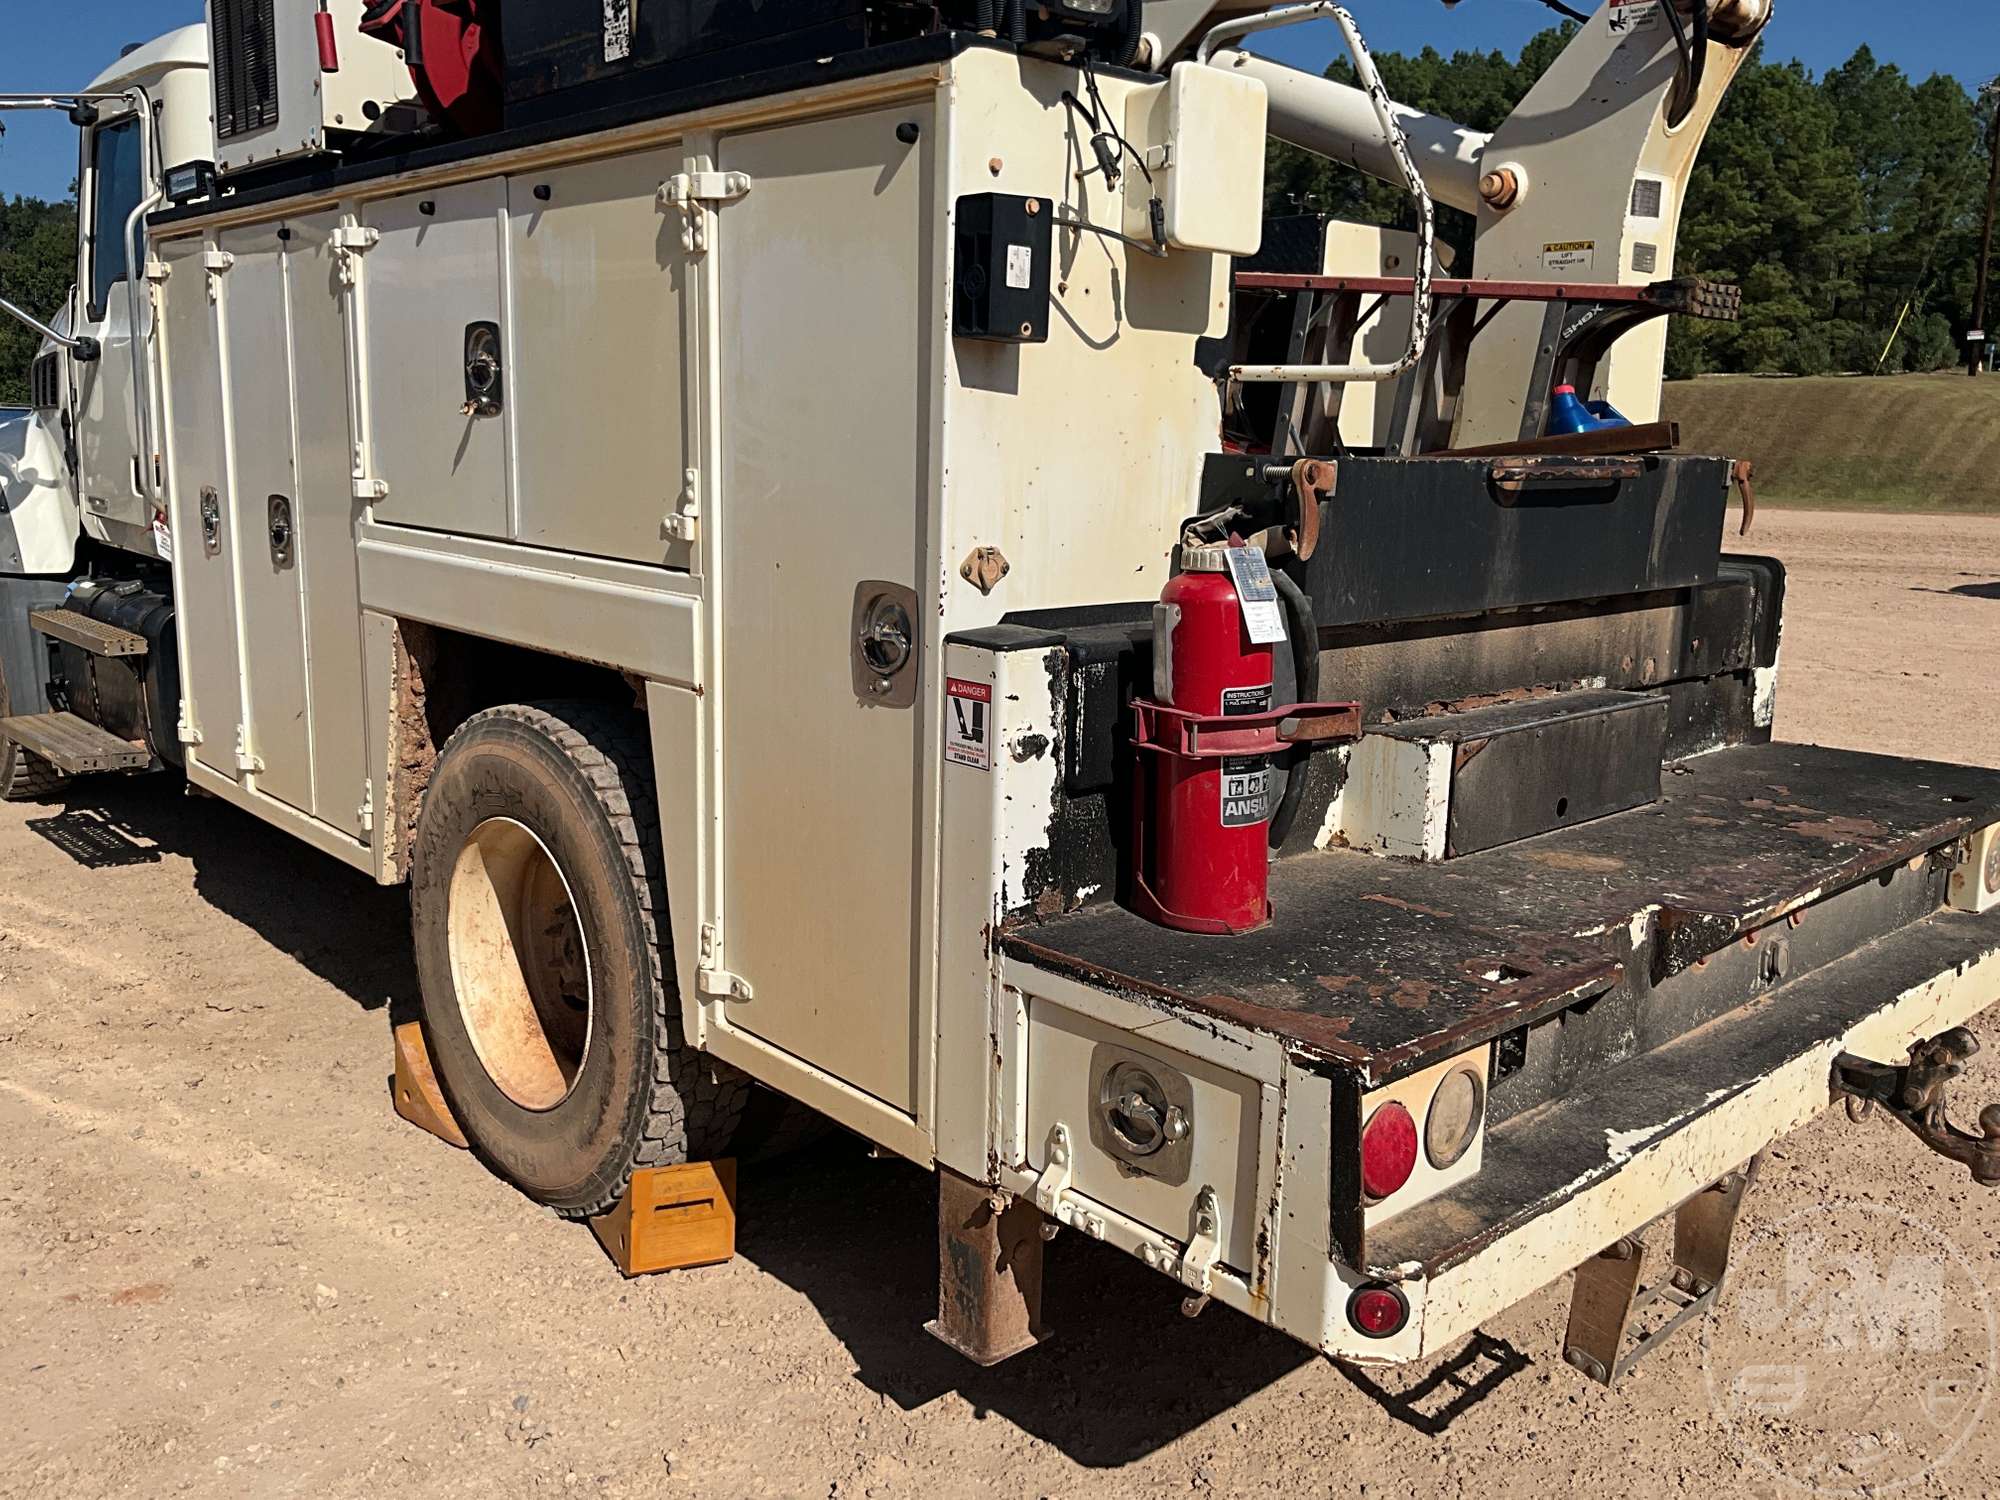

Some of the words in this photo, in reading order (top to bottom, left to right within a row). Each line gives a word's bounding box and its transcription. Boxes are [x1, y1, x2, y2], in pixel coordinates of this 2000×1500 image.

[1553, 242, 1585, 251] CAUTION
[1548, 258, 1576, 266] STRAIGHT
[957, 683, 986, 698] DANGER
[1226, 690, 1265, 699] INSTRUCTIONS
[954, 752, 966, 762] STAND
[967, 755, 980, 764] CLEAR
